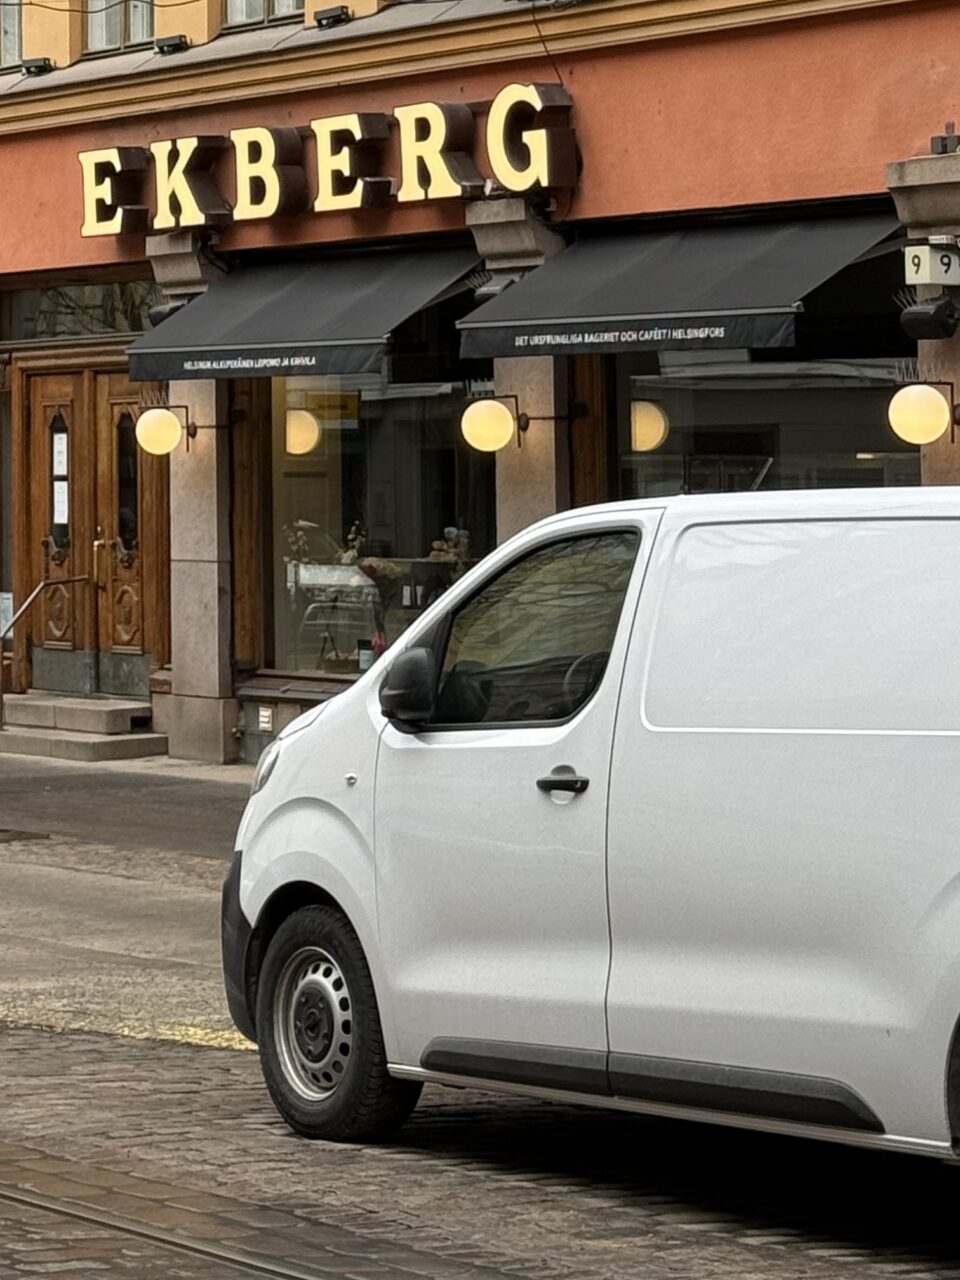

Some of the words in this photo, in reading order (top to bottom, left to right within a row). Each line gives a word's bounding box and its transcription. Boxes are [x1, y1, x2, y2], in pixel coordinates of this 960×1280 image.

[77, 82, 549, 238] EKBERG
[911, 254, 921, 275] 9
[940, 254, 952, 275] 9
[514, 336, 528, 347] DET
[620, 331, 637, 342] OCH
[672, 327, 725, 339] HELSINGFORS
[281, 357, 289, 367] JA
